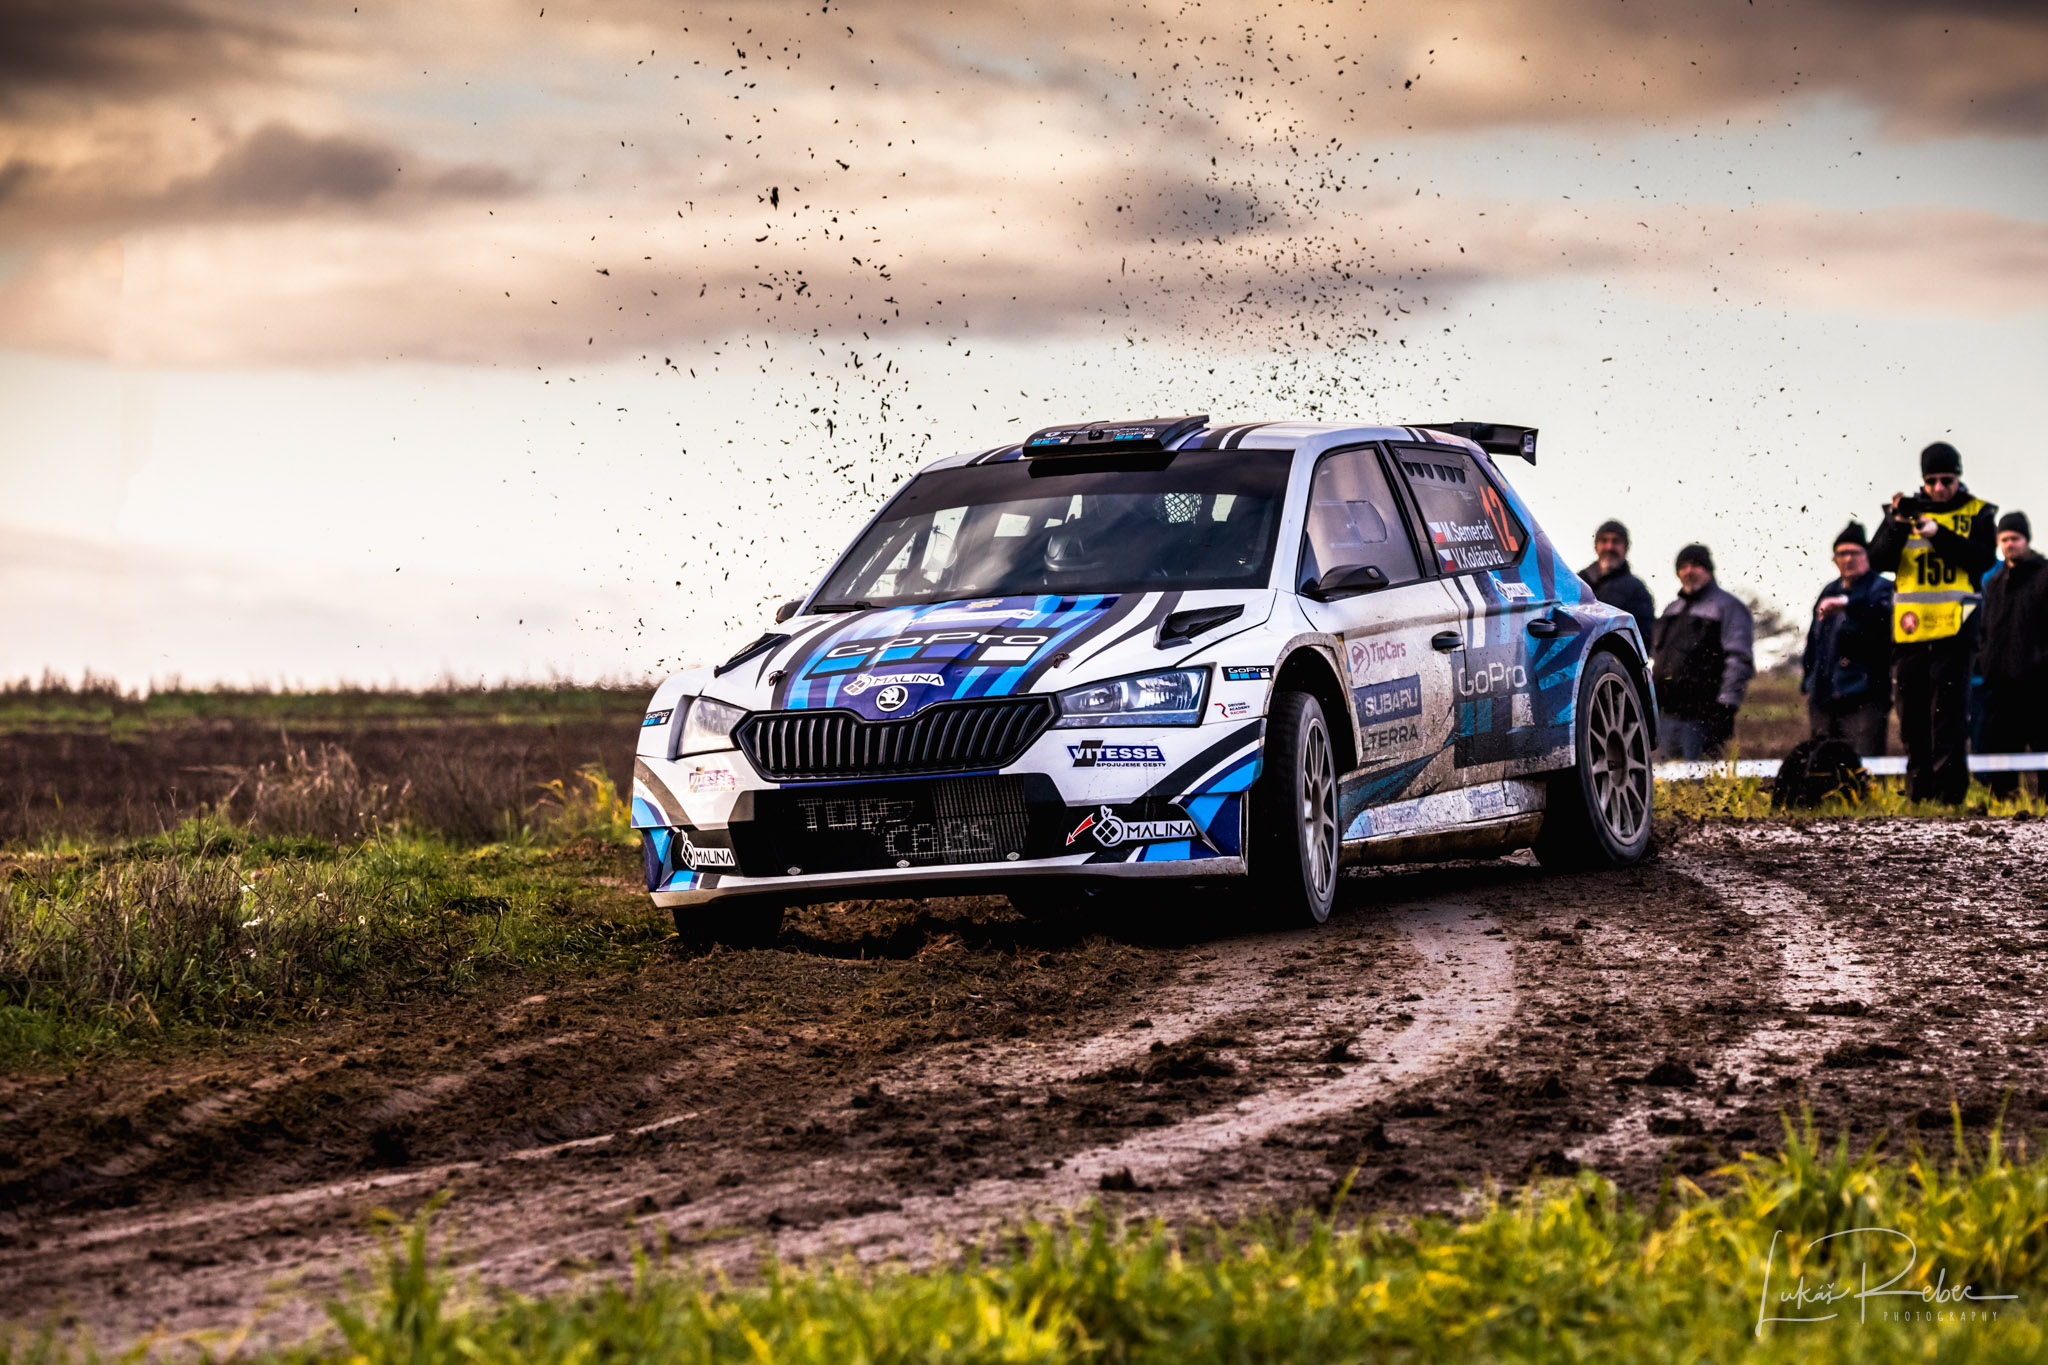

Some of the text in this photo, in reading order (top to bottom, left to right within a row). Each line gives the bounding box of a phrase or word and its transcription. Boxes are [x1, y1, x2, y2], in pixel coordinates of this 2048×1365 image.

[1480, 485, 1519, 551] 12
[1440, 520, 1494, 543] M.Semerád
[1451, 543, 1504, 569] V.Kolářová
[826, 631, 1049, 658] GoPro
[1369, 641, 1407, 665] TipCars
[874, 674, 943, 685] MALINA
[1458, 662, 1528, 697] GoPro
[1365, 687, 1418, 718] SUBARU
[645, 711, 670, 719] GoPro
[1071, 747, 1160, 760] VITESSE
[1126, 822, 1196, 839] MALINA
[695, 850, 734, 865] MALINA
